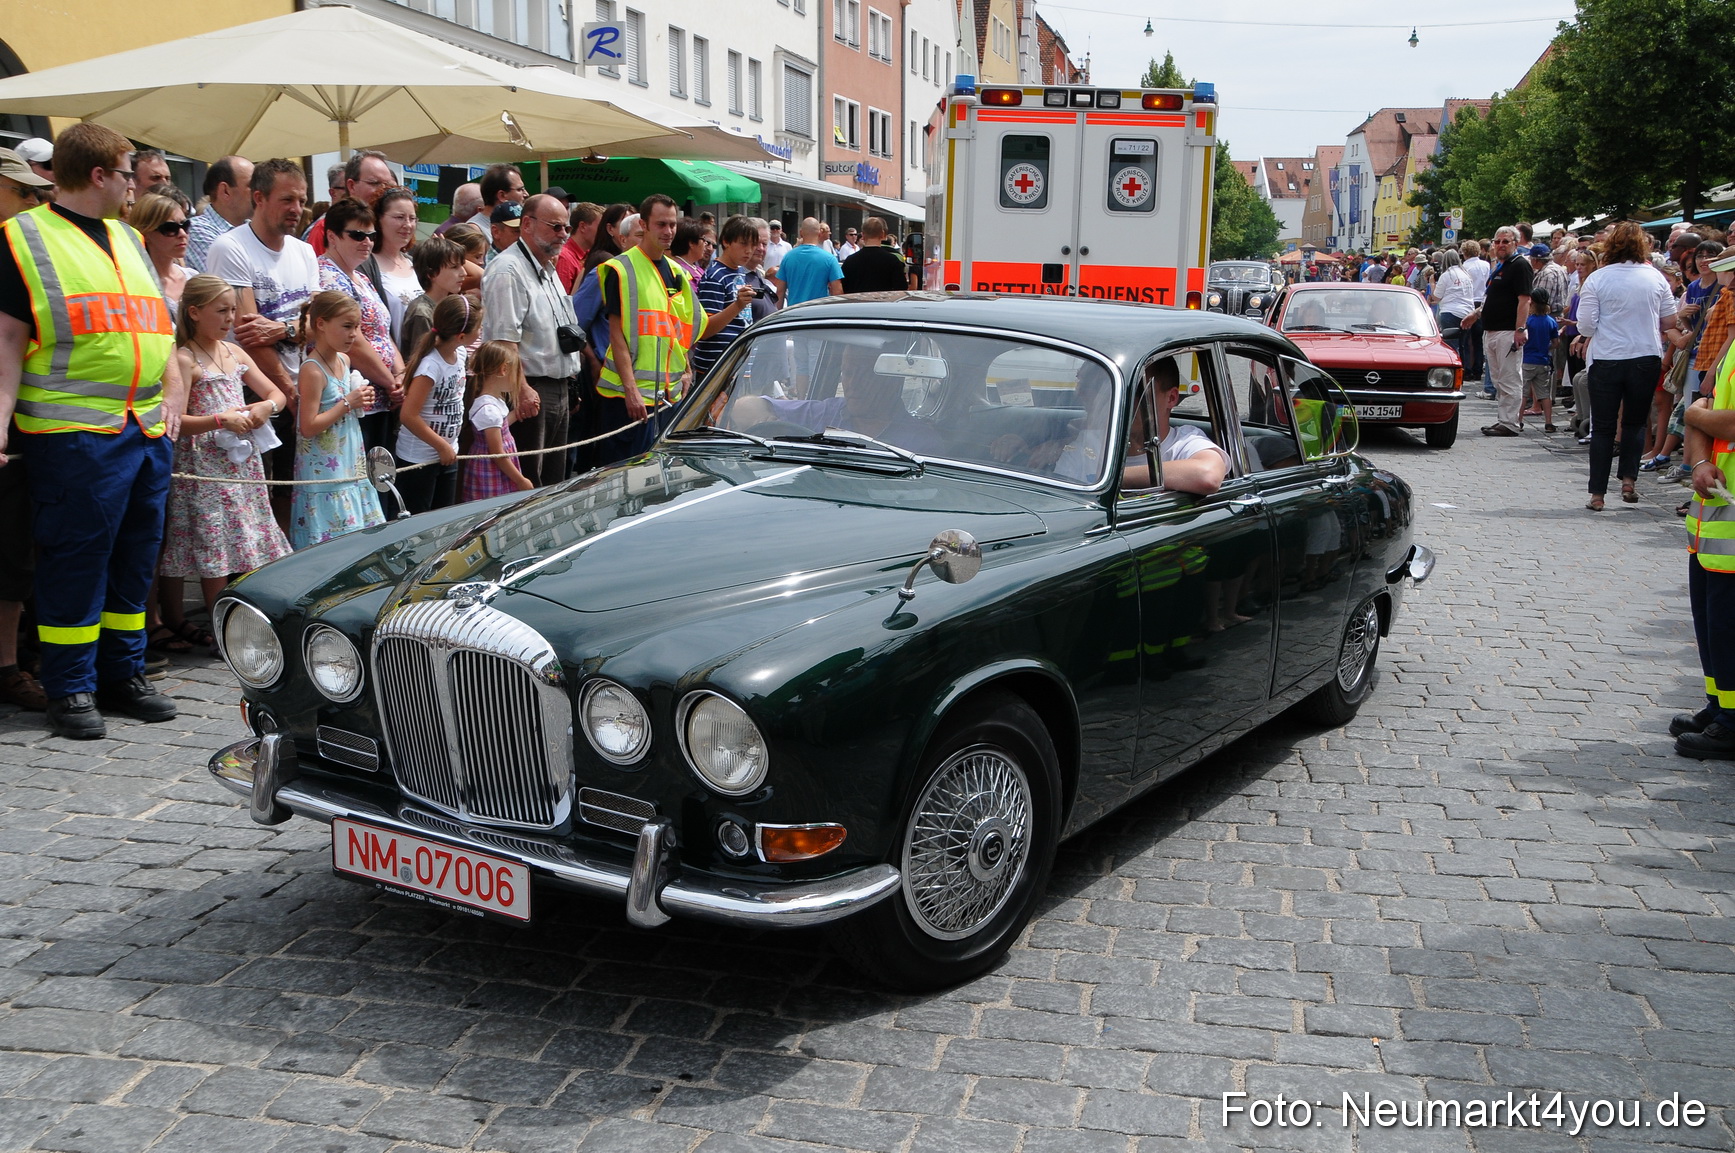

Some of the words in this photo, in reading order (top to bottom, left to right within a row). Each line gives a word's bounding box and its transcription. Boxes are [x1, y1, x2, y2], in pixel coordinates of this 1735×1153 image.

[536, 173, 630, 183] ammsbräu
[1008, 166, 1041, 183] BAYERISCHES
[1116, 170, 1149, 186] BAYERISCHES
[1008, 184, 1023, 201] ROTES
[1024, 184, 1041, 201] KREUZ
[1115, 187, 1130, 204] ROTES
[1131, 188, 1149, 204] KREUZ
[67, 295, 157, 332] THW
[1362, 407, 1375, 416] WS
[1377, 406, 1402, 416] 154H
[348, 827, 514, 907] NM-07006
[384, 885, 405, 896] Autohaus
[405, 890, 425, 901] PLATZER
[428, 897, 451, 908] Neumarkt
